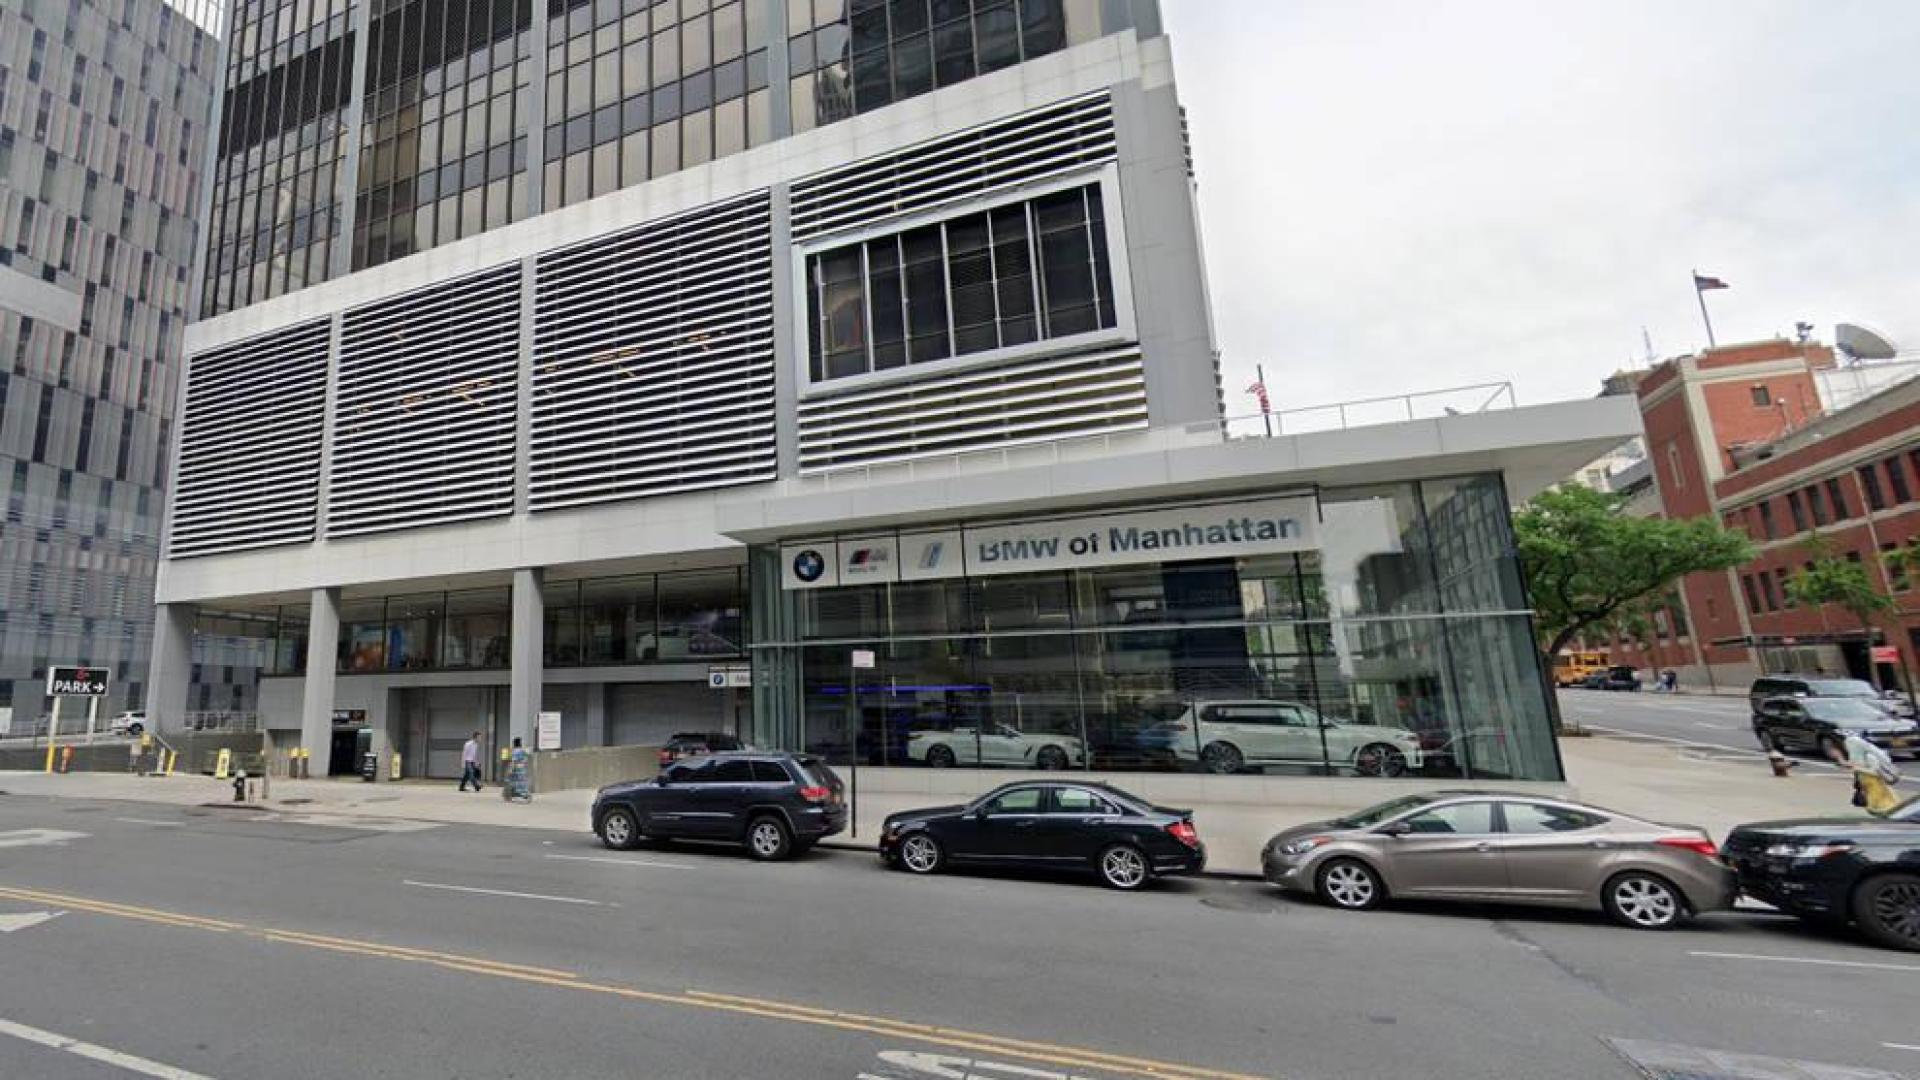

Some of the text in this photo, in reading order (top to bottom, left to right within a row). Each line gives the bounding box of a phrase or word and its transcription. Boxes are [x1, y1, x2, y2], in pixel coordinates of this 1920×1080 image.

[979, 517, 1305, 562] BMW of Manhattan
[54, 680, 92, 693] PARK
